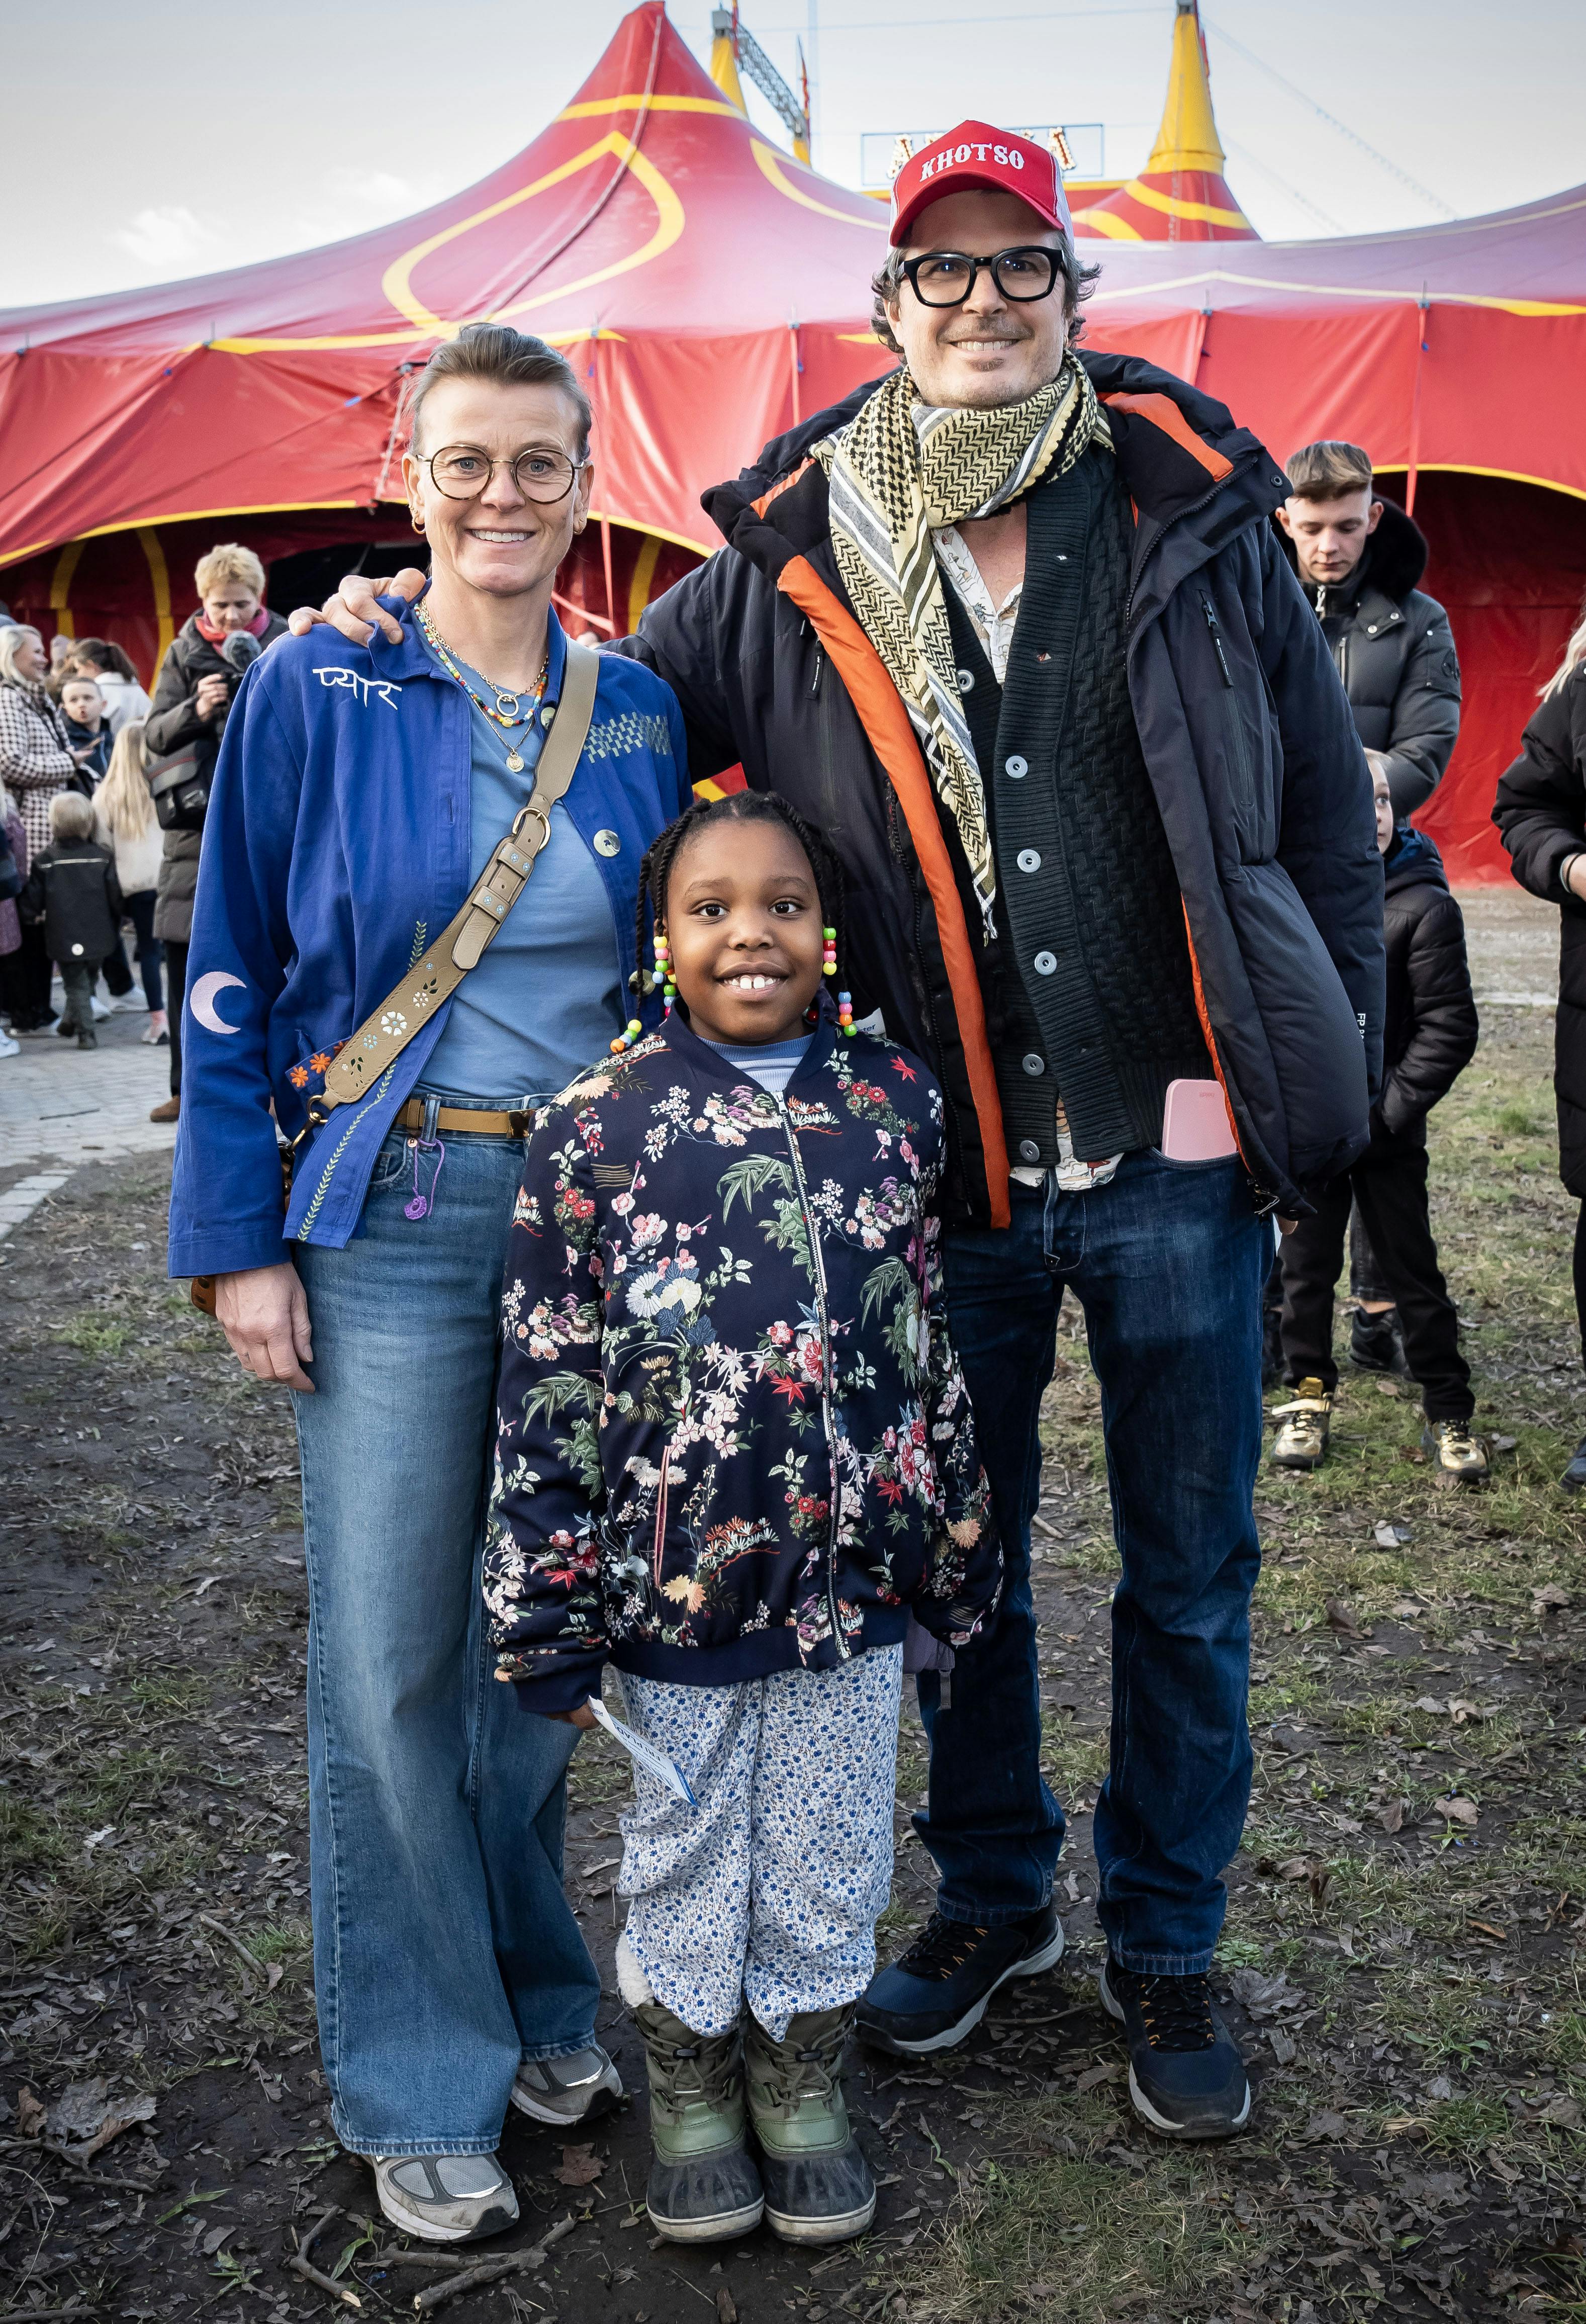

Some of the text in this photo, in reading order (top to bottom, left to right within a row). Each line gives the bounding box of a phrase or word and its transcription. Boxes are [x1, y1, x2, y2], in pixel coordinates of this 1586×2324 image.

[919, 142, 1025, 183] KHOTSO
[312, 667, 402, 710] प्यार
[1357, 1013, 1366, 1026] FP
[615, 1725, 643, 1749] PLAD
[645, 1747, 661, 1761] FRI
